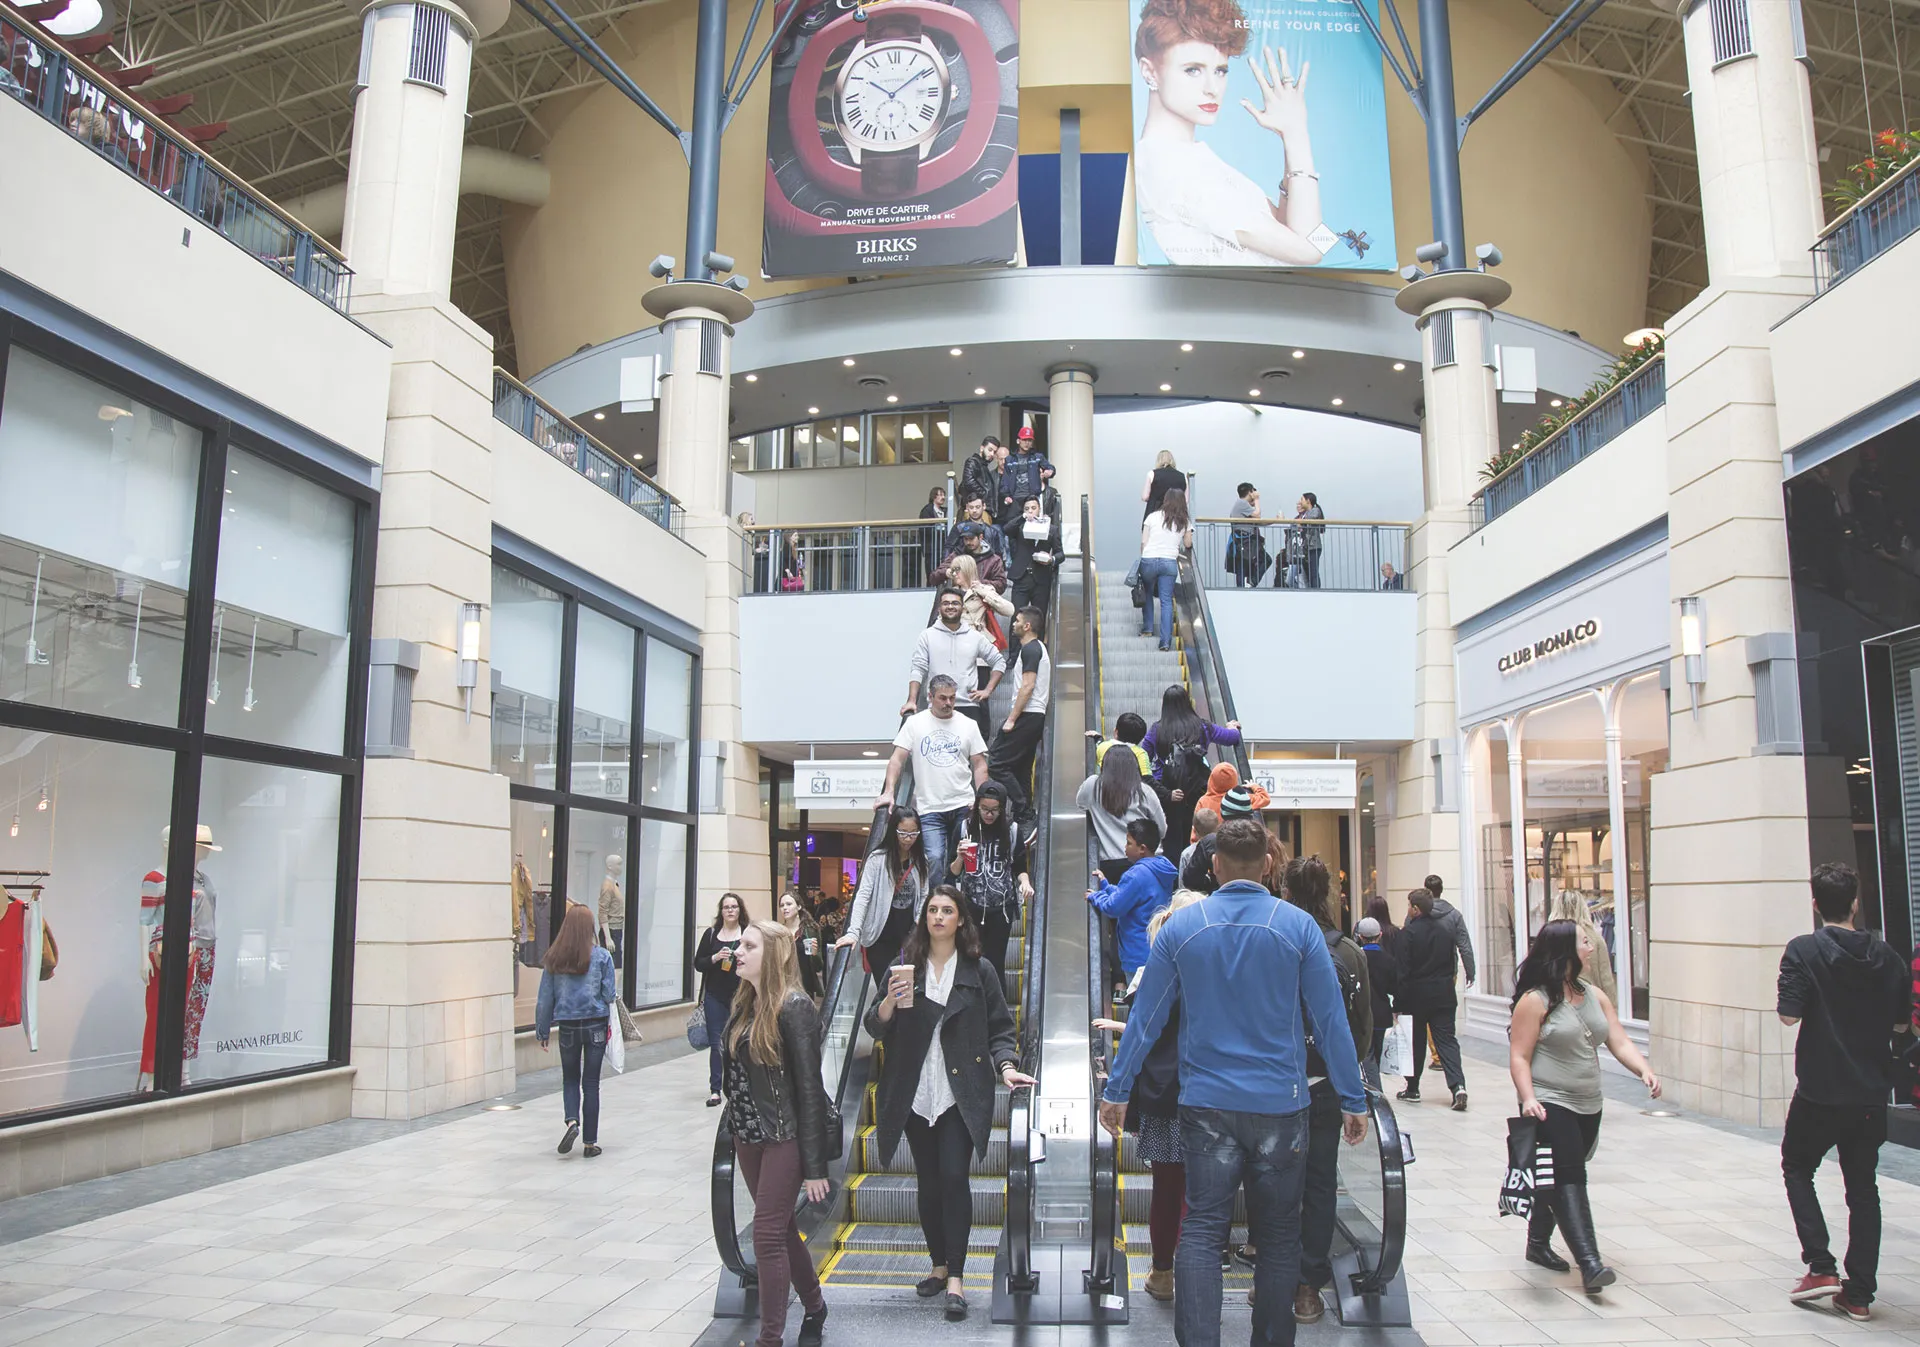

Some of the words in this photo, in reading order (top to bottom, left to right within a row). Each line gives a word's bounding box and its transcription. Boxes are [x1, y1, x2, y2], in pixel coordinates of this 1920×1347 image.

[1317, 10, 1360, 18] COLLECTION
[1234, 19, 1280, 30] REFINE
[1285, 20, 1322, 31] YOUR
[1326, 22, 1361, 33] EDGE
[846, 207, 875, 218] DRIVE
[875, 206, 889, 216] DE
[890, 204, 930, 214] CARTIER
[820, 217, 876, 227] MANUFACTURE
[878, 215, 921, 224] MOVEMENT
[855, 237, 917, 255] BIRKS
[862, 254, 903, 264] ENTRANCE
[1497, 647, 1532, 673] CLUB
[1533, 619, 1598, 659] MONACO
[836, 777, 860, 785] Elevator
[1280, 777, 1305, 785] Elevator
[1314, 777, 1340, 785] Chinook
[1280, 785, 1318, 793] Professional
[1320, 785, 1338, 793] Tower
[216, 1035, 258, 1053] BANANA
[259, 1030, 303, 1047] REPUBLIC
